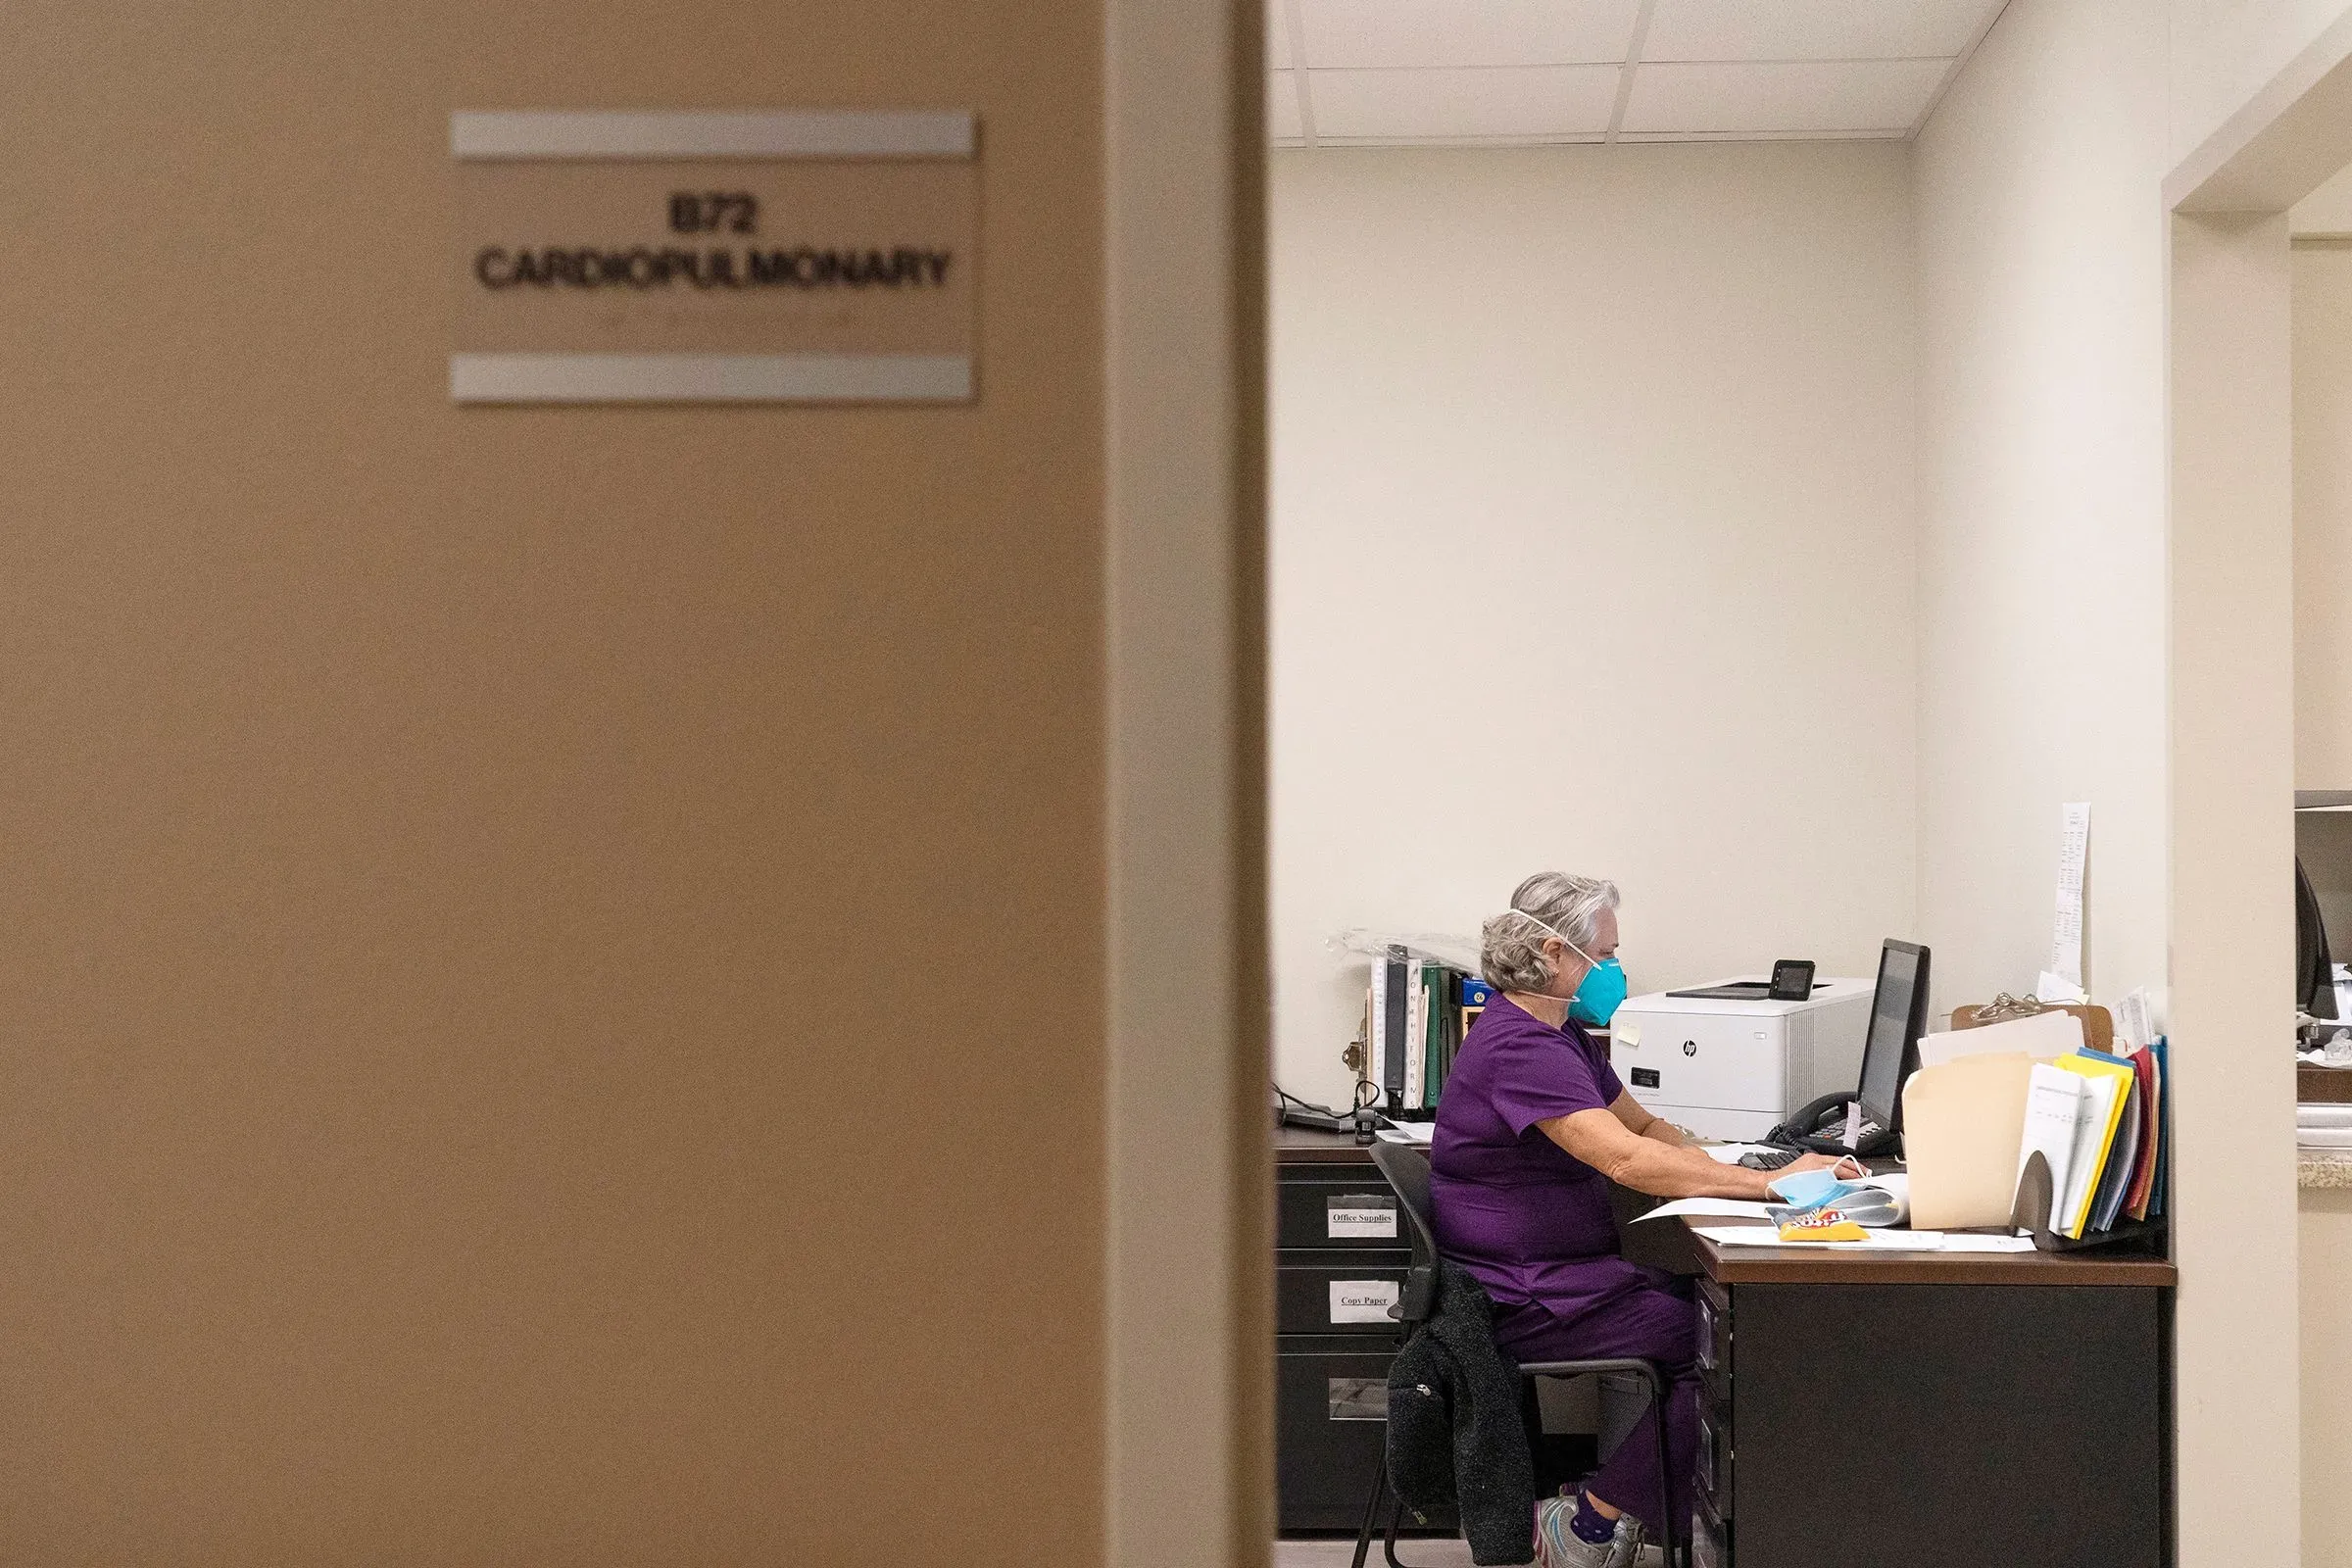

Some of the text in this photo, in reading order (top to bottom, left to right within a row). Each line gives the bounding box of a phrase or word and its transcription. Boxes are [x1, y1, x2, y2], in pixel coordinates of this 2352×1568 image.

[668, 191, 760, 233] B72
[474, 247, 951, 288] CARDIOPULMONARY
[1684, 1040, 1696, 1056] hp
[1333, 1213, 1392, 1223] Office Supplies
[1341, 1297, 1388, 1306] Copy Paper
